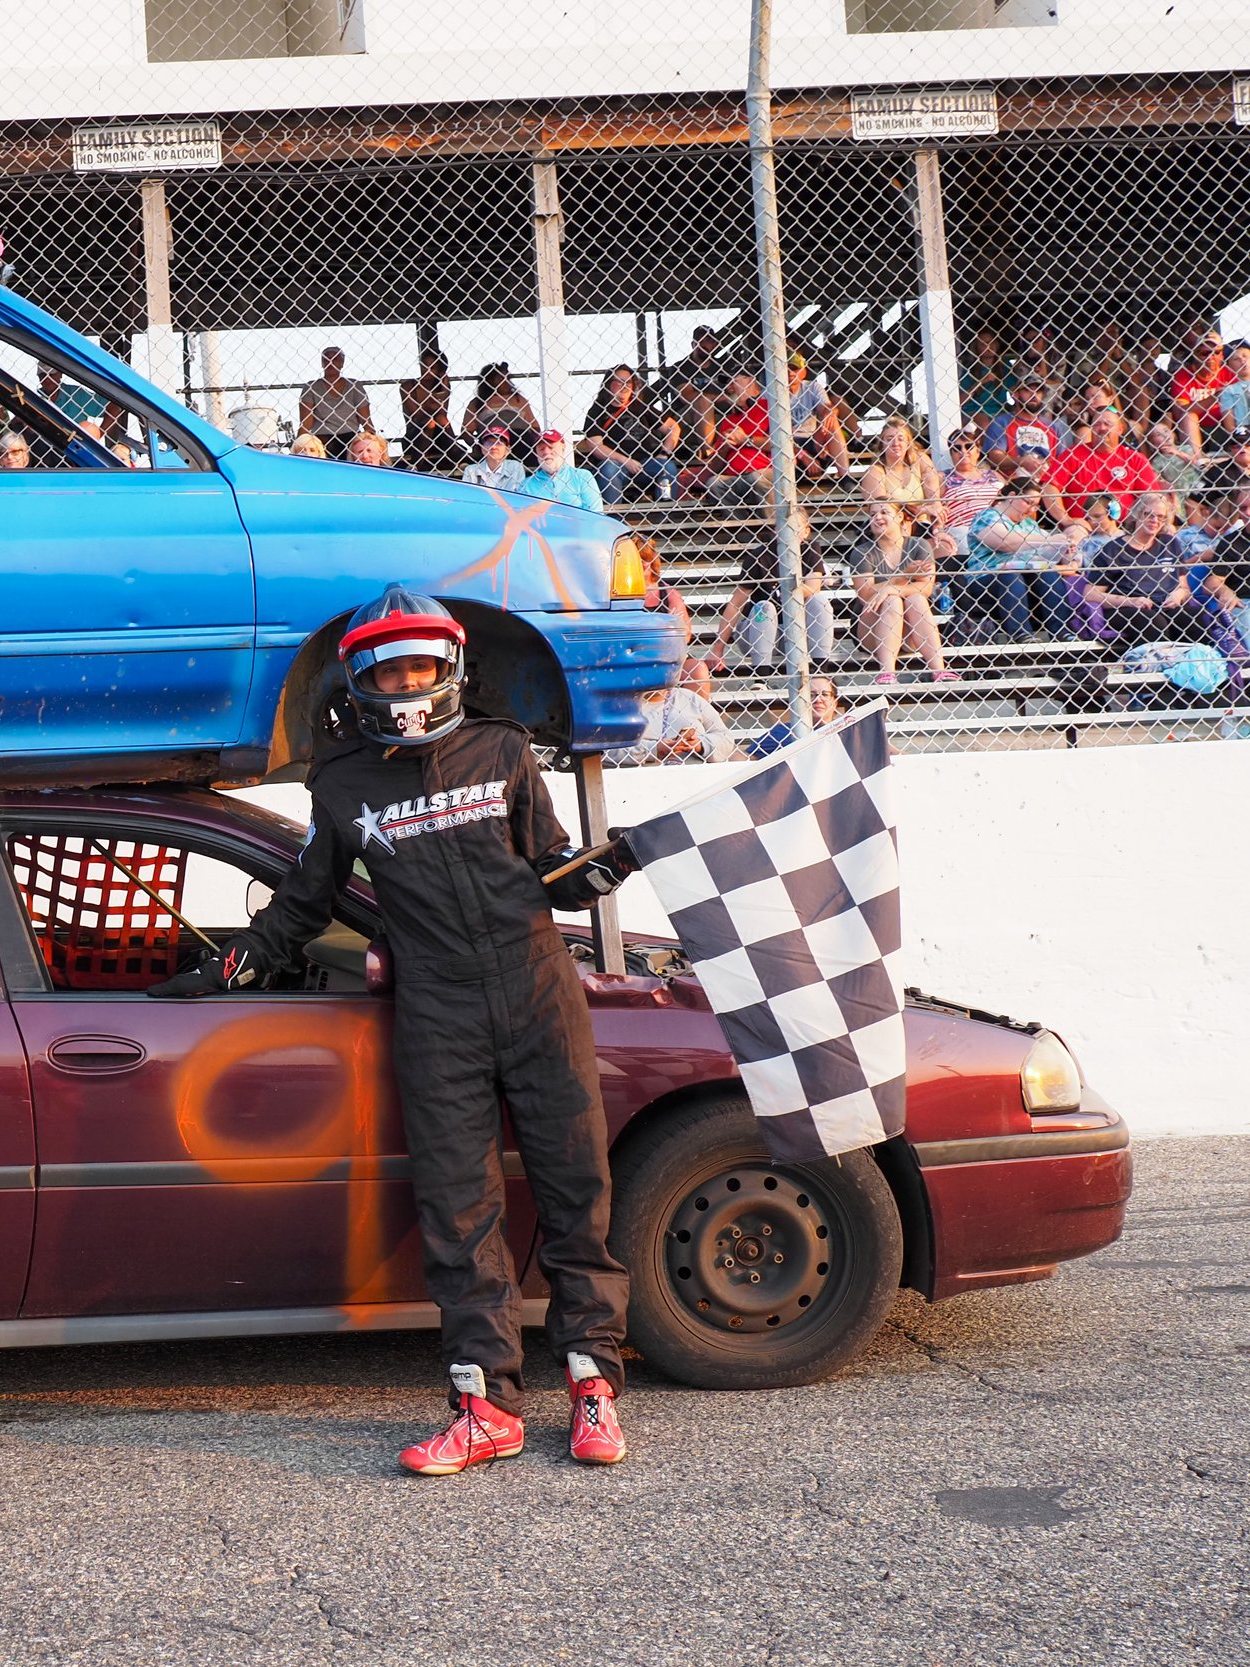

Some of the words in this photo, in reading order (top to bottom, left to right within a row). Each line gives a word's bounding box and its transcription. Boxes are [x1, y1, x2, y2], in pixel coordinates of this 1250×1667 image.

[857, 97, 914, 117] FAMILY
[920, 94, 994, 113] SECTION
[858, 121, 872, 130] NO
[874, 118, 922, 130] SMOKING
[932, 117, 945, 126] NO
[948, 115, 992, 126] ALCOHOL
[78, 130, 137, 151] FAMILY
[141, 126, 215, 147] SECTION
[80, 154, 93, 165] NO
[96, 151, 145, 163] SMOKING
[154, 150, 168, 160] NO
[170, 148, 215, 160] ALCOHOL
[379, 780, 507, 825] ALLSTAR
[387, 803, 508, 842] PERFORMANCE
